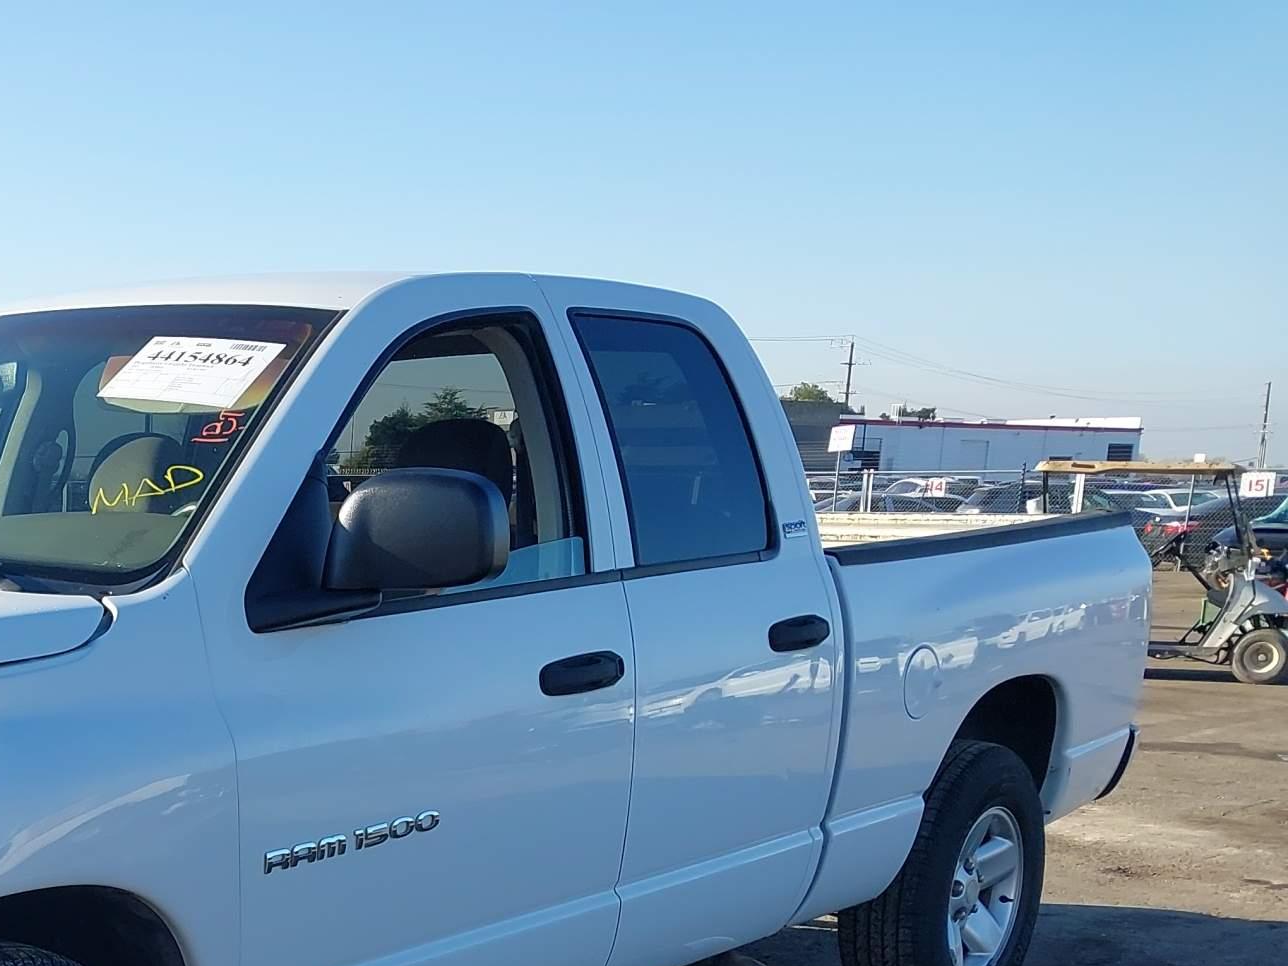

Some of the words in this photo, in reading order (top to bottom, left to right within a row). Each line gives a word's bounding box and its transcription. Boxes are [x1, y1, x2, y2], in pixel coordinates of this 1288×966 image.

[147, 349, 255, 368] 44154864
[92, 465, 204, 515] MAD
[264, 833, 347, 874] RAM
[353, 809, 441, 850] 1500
